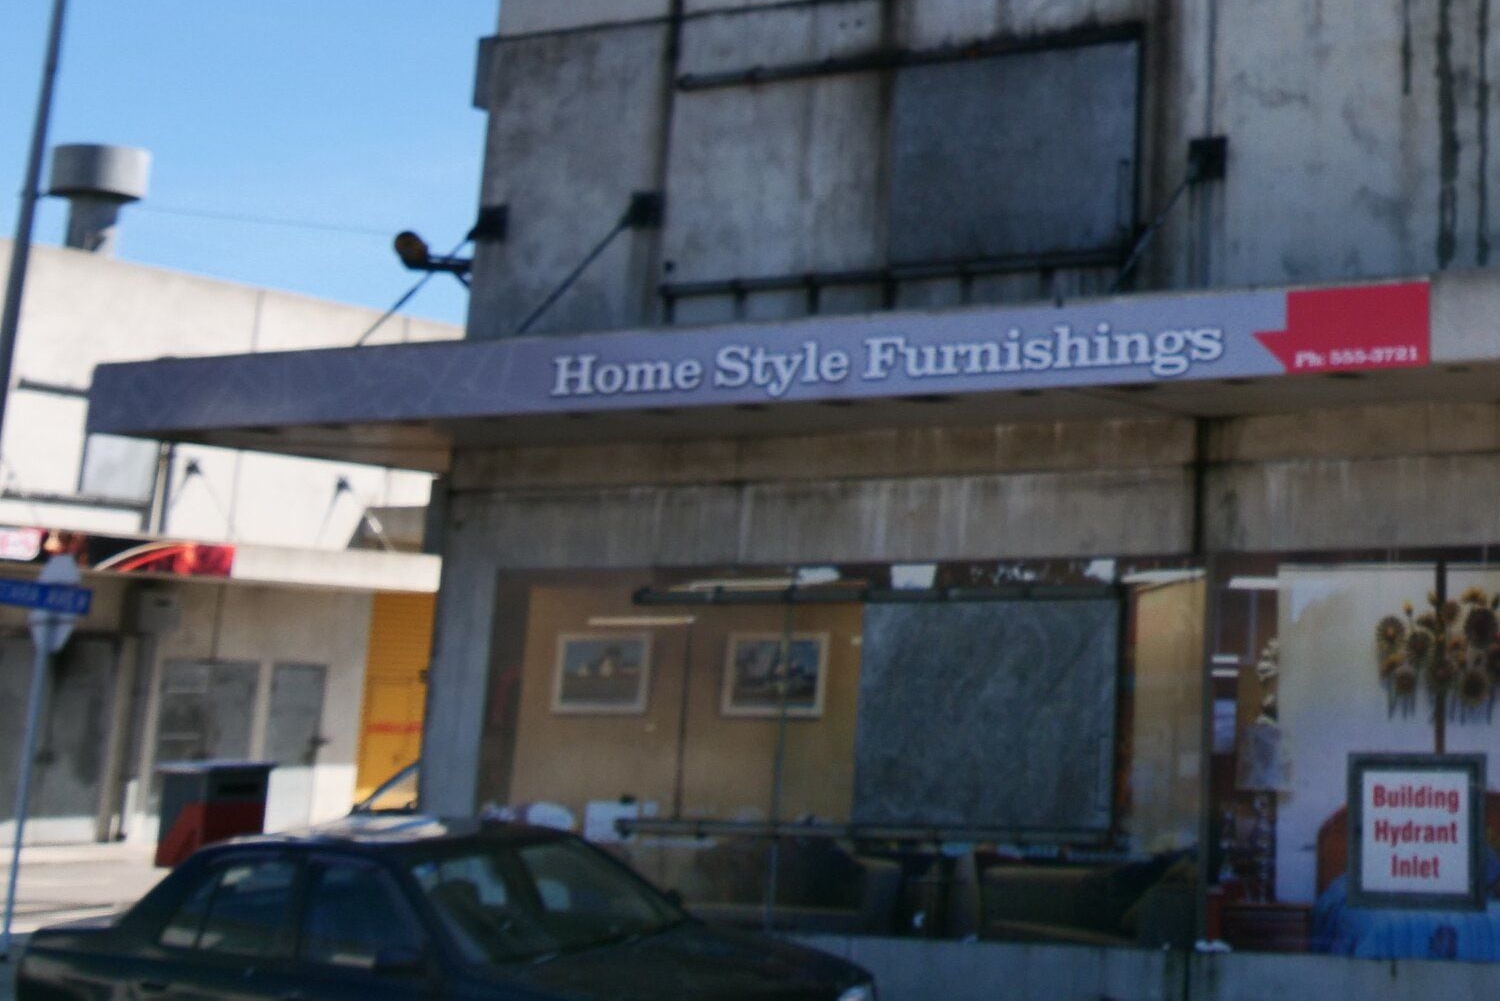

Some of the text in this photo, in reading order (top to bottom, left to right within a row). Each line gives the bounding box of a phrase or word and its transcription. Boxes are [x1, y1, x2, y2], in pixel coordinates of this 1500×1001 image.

[552, 323, 1224, 397] Home Style Furnishings
[1373, 784, 1459, 813] Building
[1374, 819, 1457, 848] Hydrant
[1391, 854, 1440, 878] Inlet
